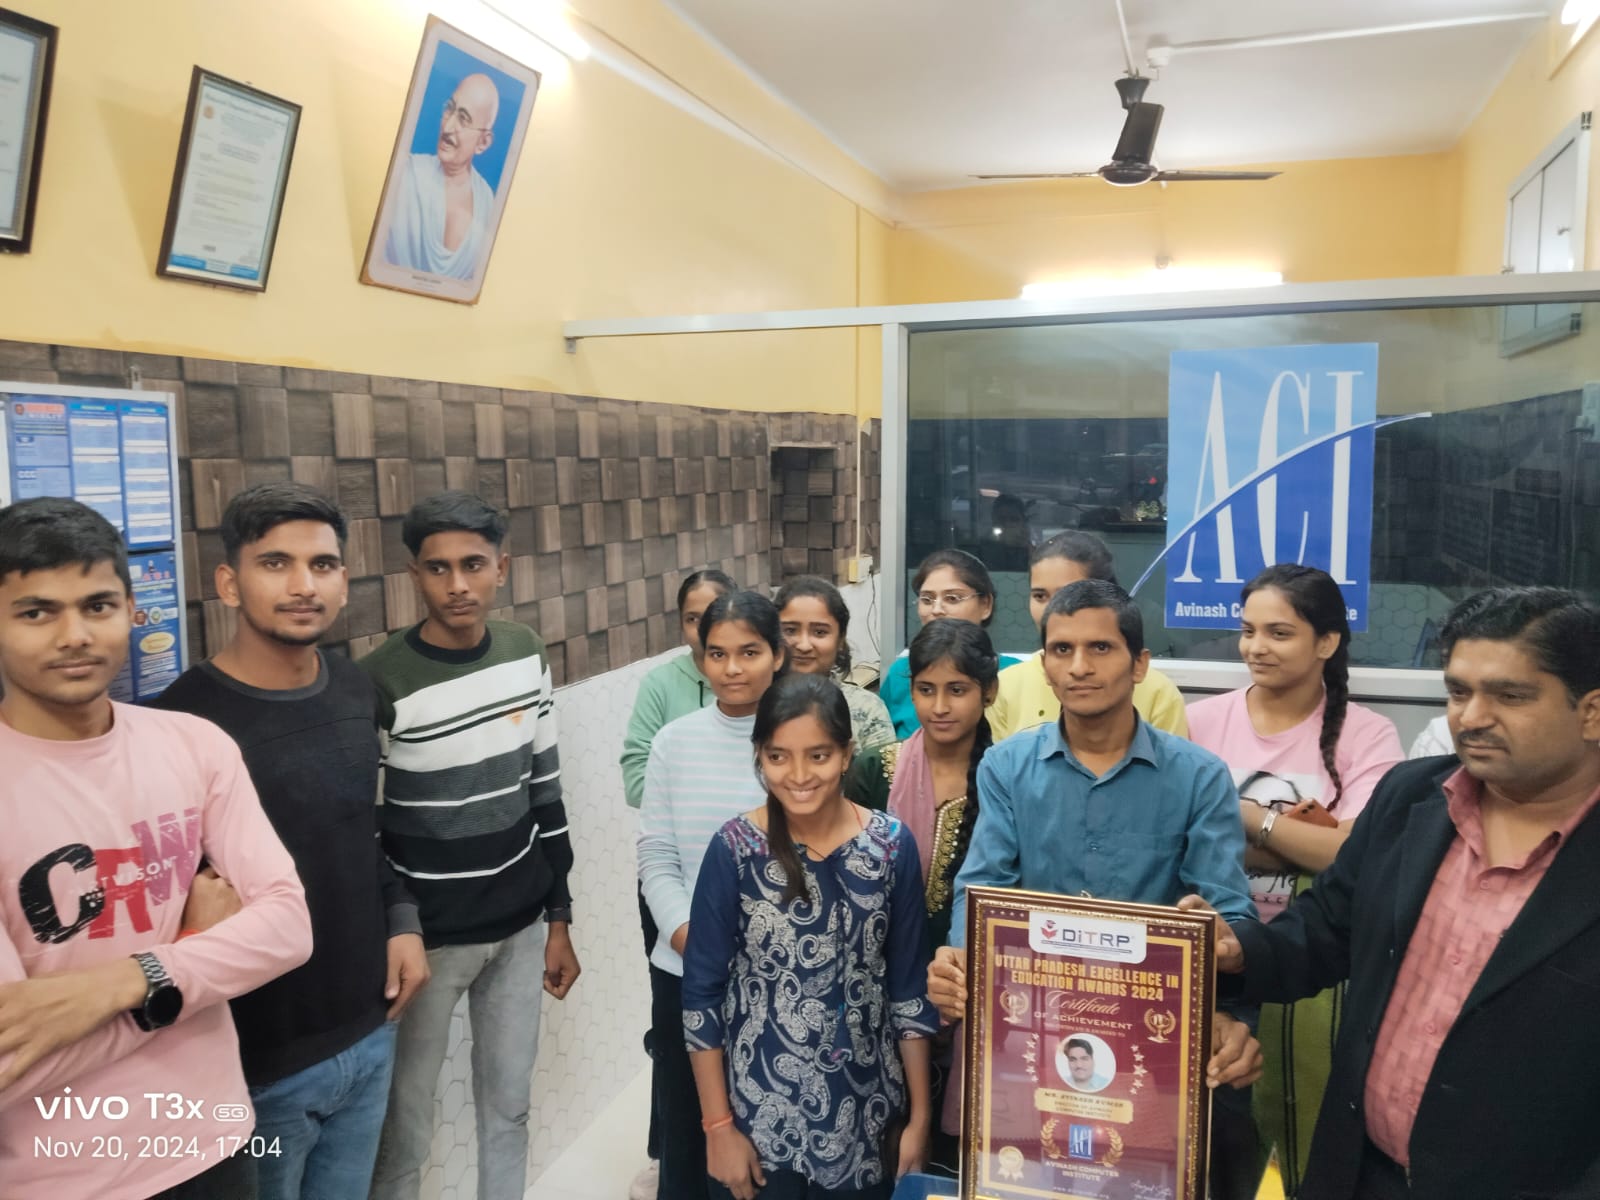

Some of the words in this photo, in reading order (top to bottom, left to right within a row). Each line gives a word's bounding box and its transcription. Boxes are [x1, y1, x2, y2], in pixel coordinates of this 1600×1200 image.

[1173, 371, 1364, 585] ACI
[1175, 602, 1227, 618] Avinash
[995, 954, 1030, 970] UTTAR
[1034, 959, 1086, 977] PRADESH
[1090, 966, 1162, 987] EXCELLENCE
[1166, 974, 1179, 989] IN
[1011, 970, 1073, 990] EDUCATION
[1077, 978, 1127, 997] AWARDS
[1131, 985, 1164, 1001] 2024
[1046, 990, 1120, 1016] Certificate
[1052, 1014, 1133, 1030] ACHIEVEMENT
